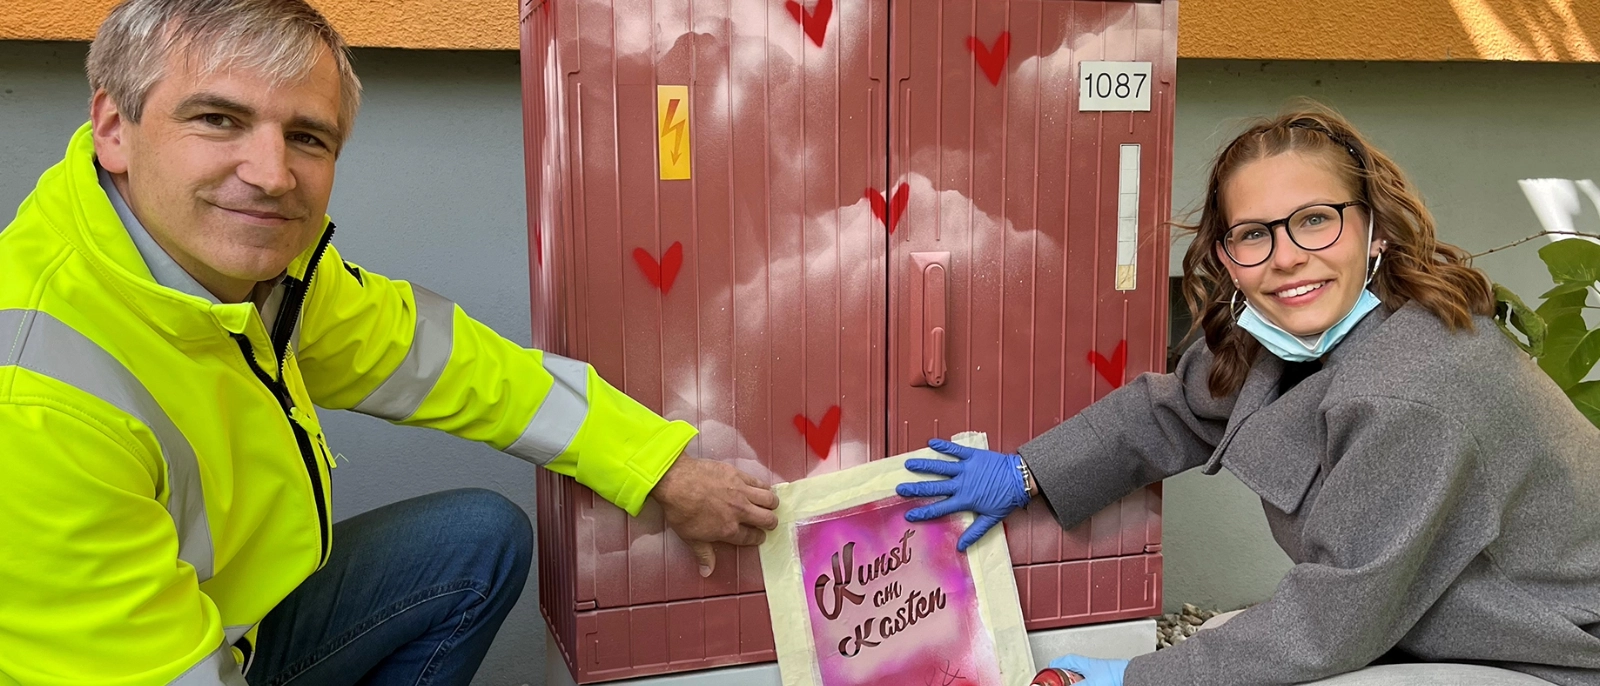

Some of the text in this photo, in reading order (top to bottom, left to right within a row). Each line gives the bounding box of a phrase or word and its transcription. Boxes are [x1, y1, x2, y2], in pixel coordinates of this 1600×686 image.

[1084, 72, 1147, 98] 1087
[814, 528, 916, 620] Kunst
[873, 581, 902, 608] am
[838, 586, 946, 658] Kasten
